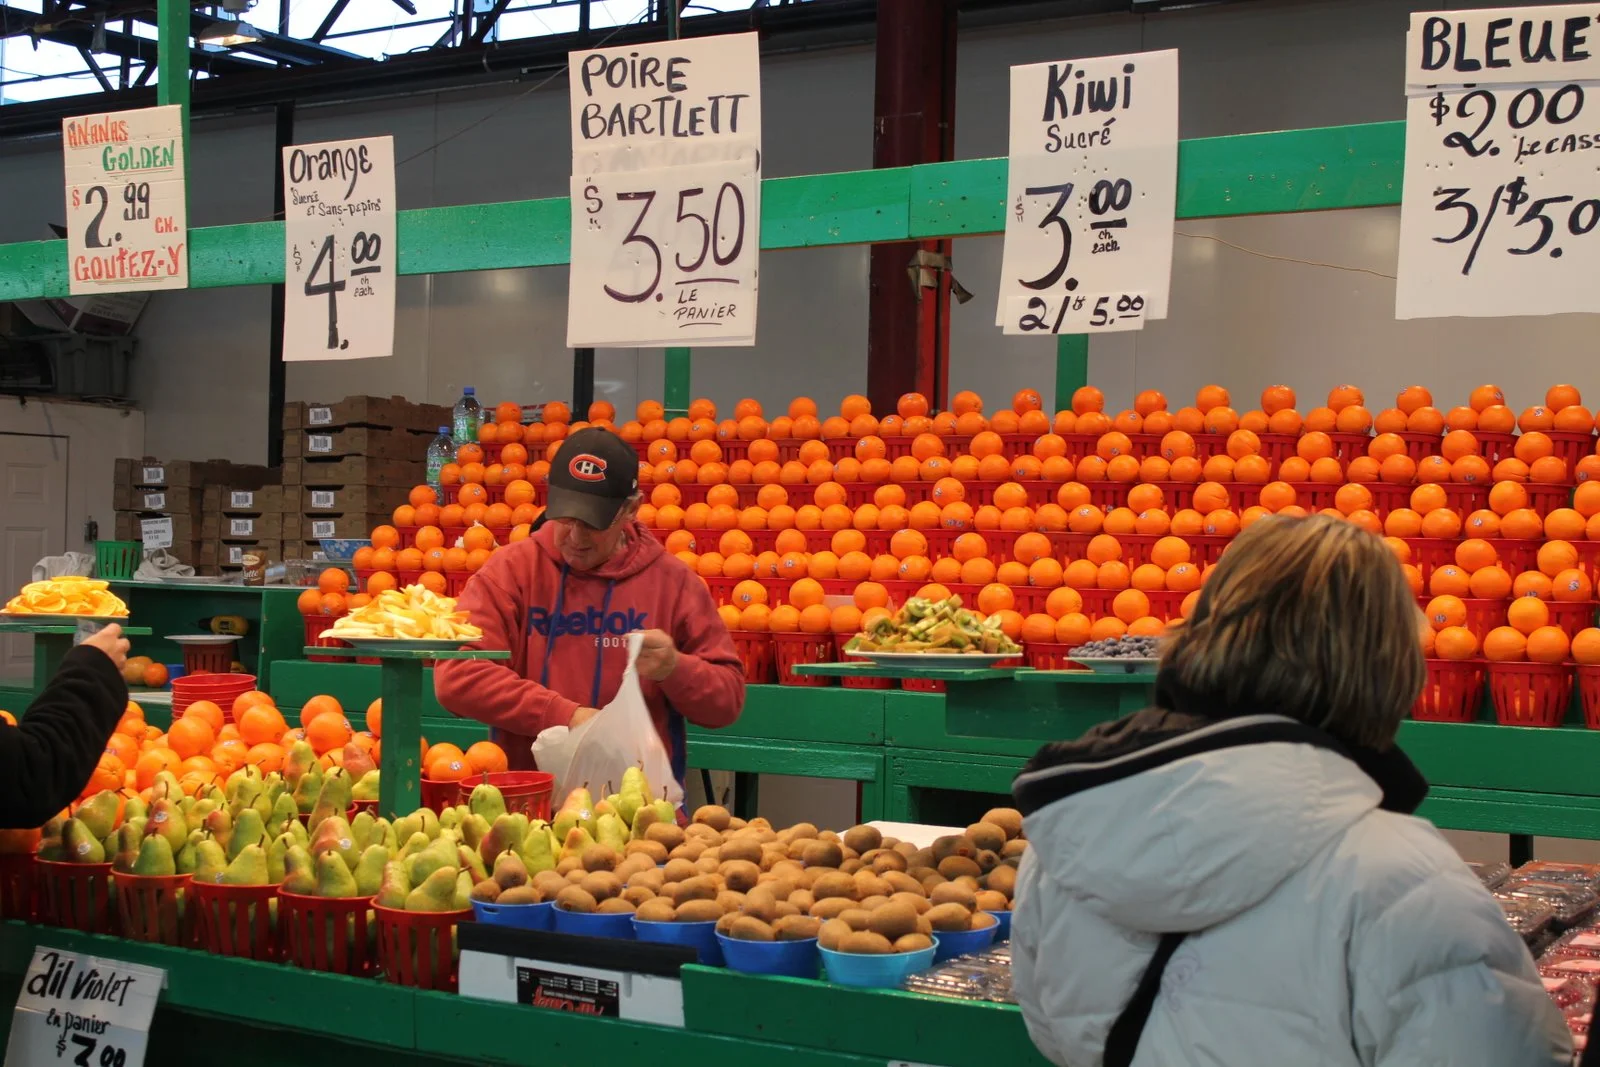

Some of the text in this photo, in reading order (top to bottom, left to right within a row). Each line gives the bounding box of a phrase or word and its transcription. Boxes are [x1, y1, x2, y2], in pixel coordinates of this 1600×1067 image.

[1421, 16, 1600, 71] BLEUE
[1042, 63, 1135, 121] Kiwi
[67, 116, 128, 147] ANANAS
[581, 95, 750, 139] BARTLETT
[1045, 117, 1116, 153] Sucré
[289, 145, 373, 200] Orange
[678, 289, 698, 304] LE
[528, 605, 647, 636] Reebok
